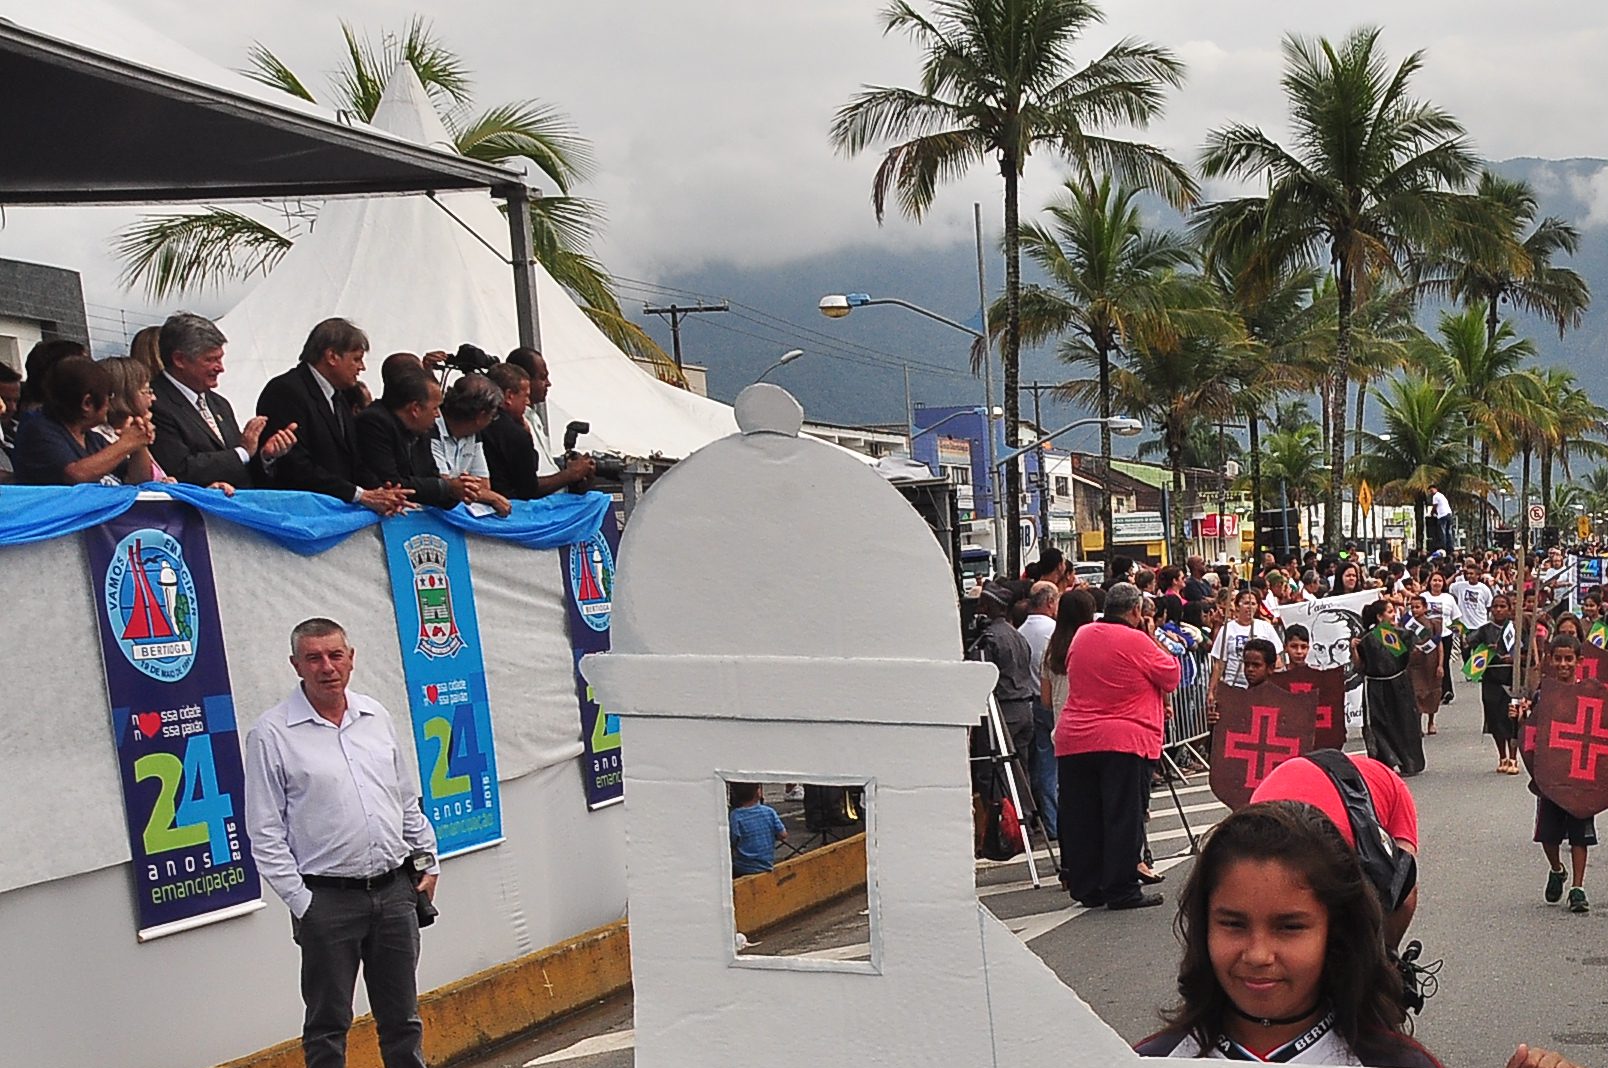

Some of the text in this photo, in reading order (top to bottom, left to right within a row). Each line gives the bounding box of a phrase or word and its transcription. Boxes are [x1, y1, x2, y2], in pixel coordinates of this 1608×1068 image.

[110, 555, 125, 611] VAMOS
[141, 645, 188, 657] BERTIOGA
[424, 703, 488, 811] 24
[134, 733, 234, 866] 24
[433, 799, 473, 821] anos
[148, 852, 213, 882] anos
[151, 866, 246, 905] emancipação
